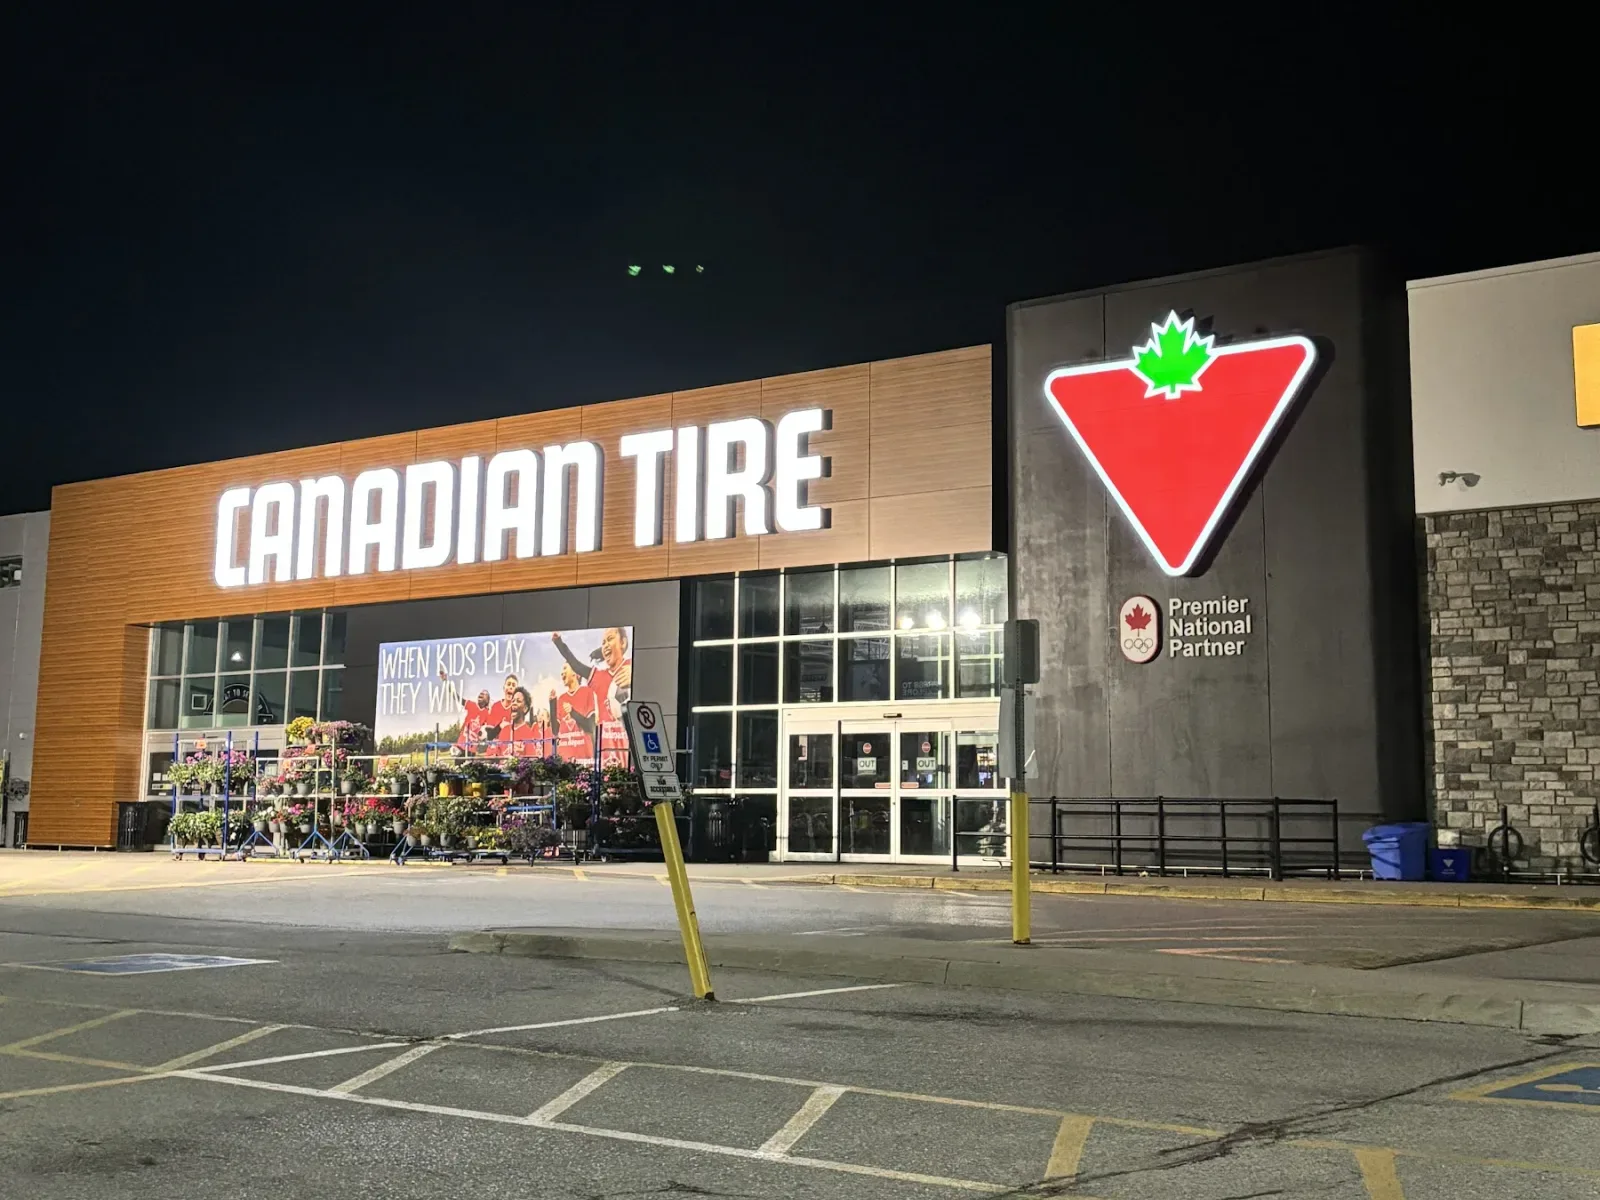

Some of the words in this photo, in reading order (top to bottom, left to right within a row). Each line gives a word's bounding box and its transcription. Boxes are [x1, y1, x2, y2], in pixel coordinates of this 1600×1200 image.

[212, 438, 600, 588] CANADIAN
[619, 407, 828, 549] TIRE
[1168, 595, 1250, 617] Premier
[1169, 615, 1252, 637] National
[1169, 638, 1246, 658] Partner
[381, 646, 431, 681] WHEN
[436, 641, 477, 678] KIDS
[484, 639, 526, 678] PLAY,
[232, 688, 241, 697] TO
[380, 682, 422, 716] THEY
[650, 762, 664, 770] ONLY
[858, 759, 876, 768] OUT
[917, 759, 935, 768] OUT
